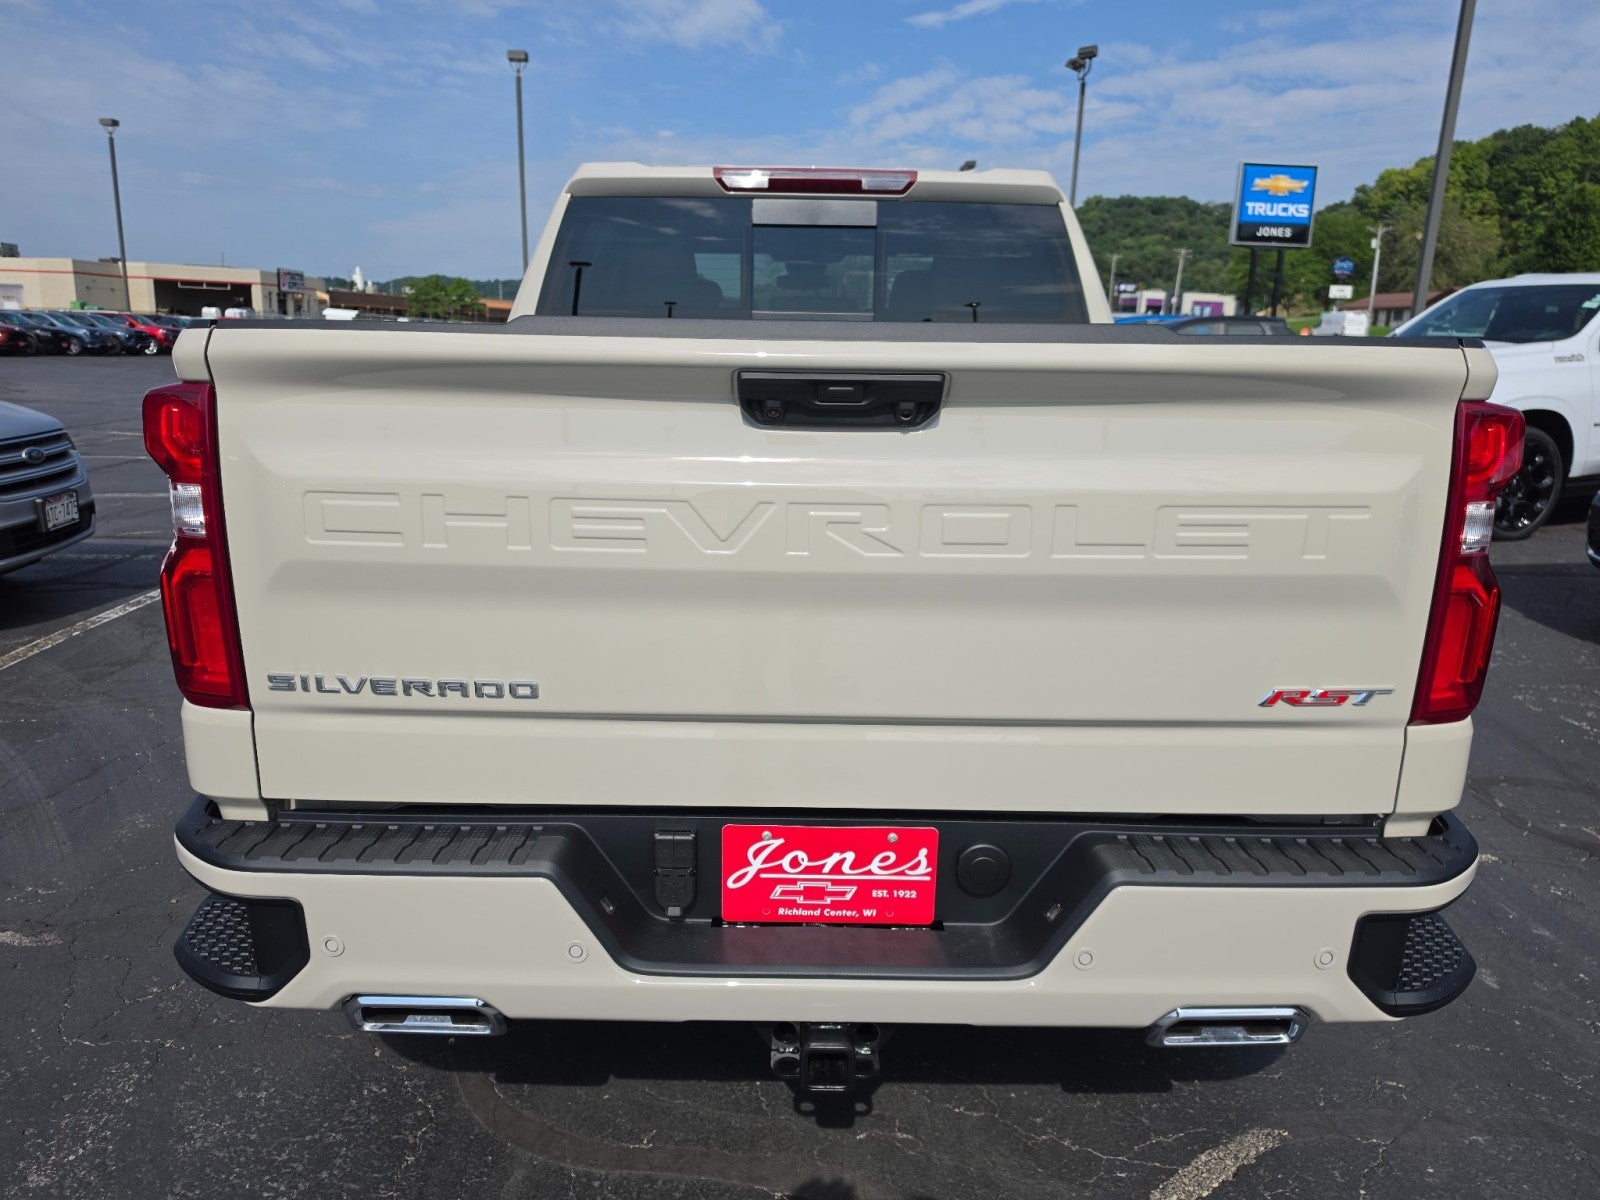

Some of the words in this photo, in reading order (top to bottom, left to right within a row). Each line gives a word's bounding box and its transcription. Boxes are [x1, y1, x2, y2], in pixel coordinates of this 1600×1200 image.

[1245, 202, 1310, 218] TRUCKS
[1255, 226, 1292, 238] JONES
[303, 490, 1371, 560] CHEVROLET
[267, 672, 540, 700] SILVERADO
[1257, 688, 1396, 708] RST
[726, 837, 933, 889] Jones
[871, 889, 889, 899] EST.
[892, 890, 917, 899] 1922
[777, 907, 821, 917] Richland
[823, 908, 859, 918] Center,
[862, 908, 877, 918] WI
